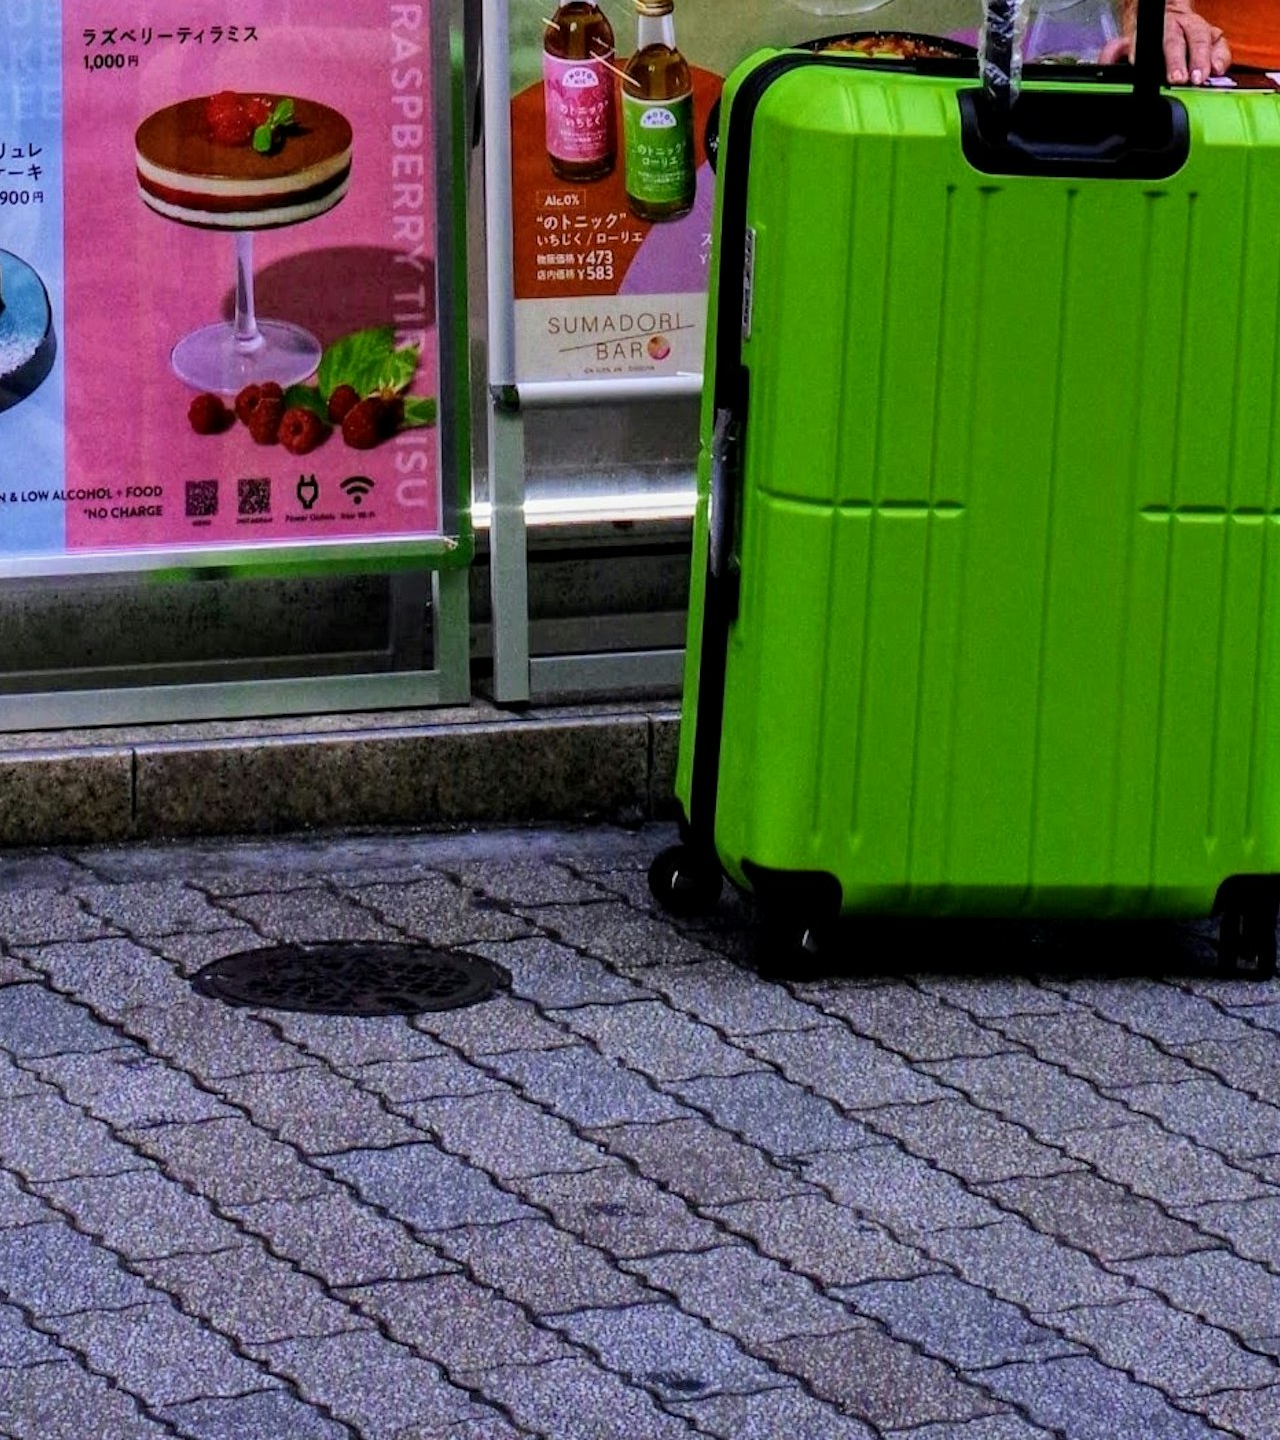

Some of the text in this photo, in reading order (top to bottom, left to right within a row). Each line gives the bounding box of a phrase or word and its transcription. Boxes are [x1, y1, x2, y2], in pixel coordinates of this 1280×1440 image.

[83, 53, 139, 71] 1,000円
[547, 313, 682, 334] SUMADORI
[596, 342, 644, 360] BAR
[9, 492, 18, 502] &
[21, 491, 48, 502] LOW
[52, 488, 113, 501] ALCOHOL
[126, 486, 163, 498] FOOD
[111, 506, 163, 518] CHARGE
